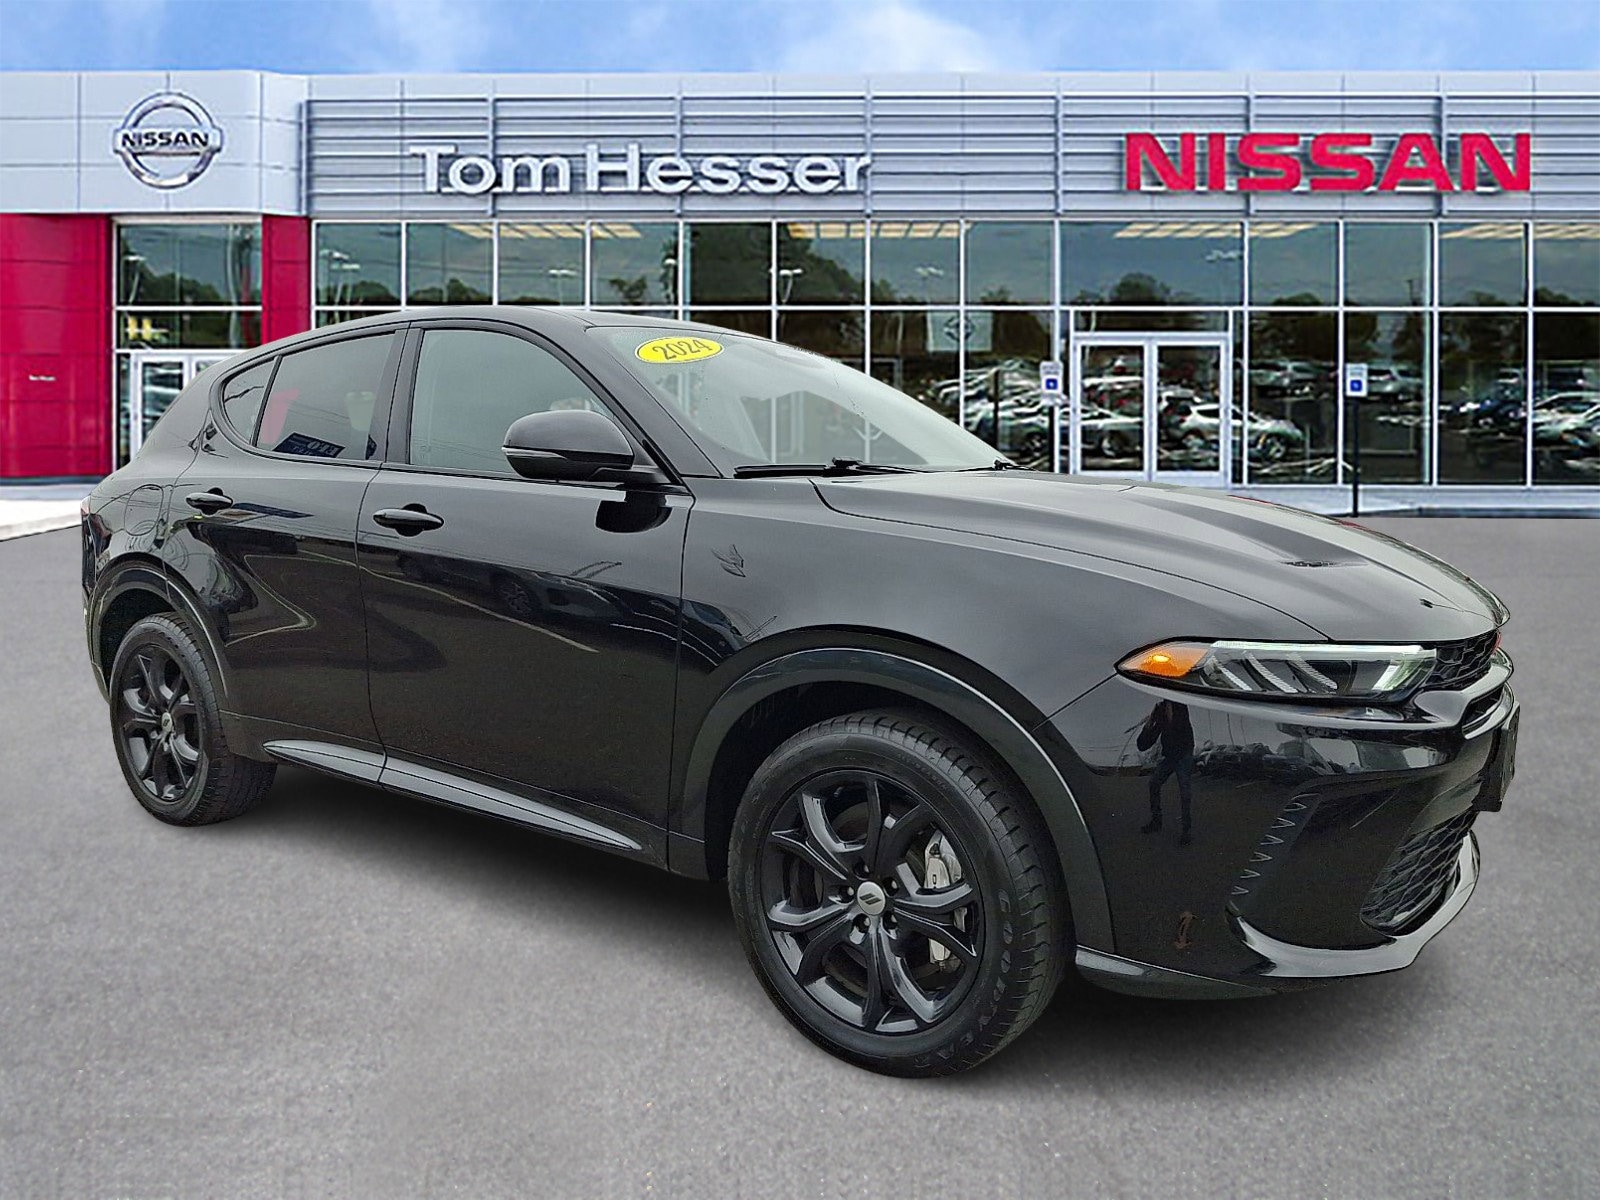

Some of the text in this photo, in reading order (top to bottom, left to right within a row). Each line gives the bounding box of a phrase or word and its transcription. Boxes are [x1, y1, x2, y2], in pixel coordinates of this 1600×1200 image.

[121, 131, 209, 147] NISSAN
[408, 142, 871, 194] Tom Hesser
[1124, 132, 1531, 191] NISSAN
[652, 339, 713, 360] 2024
